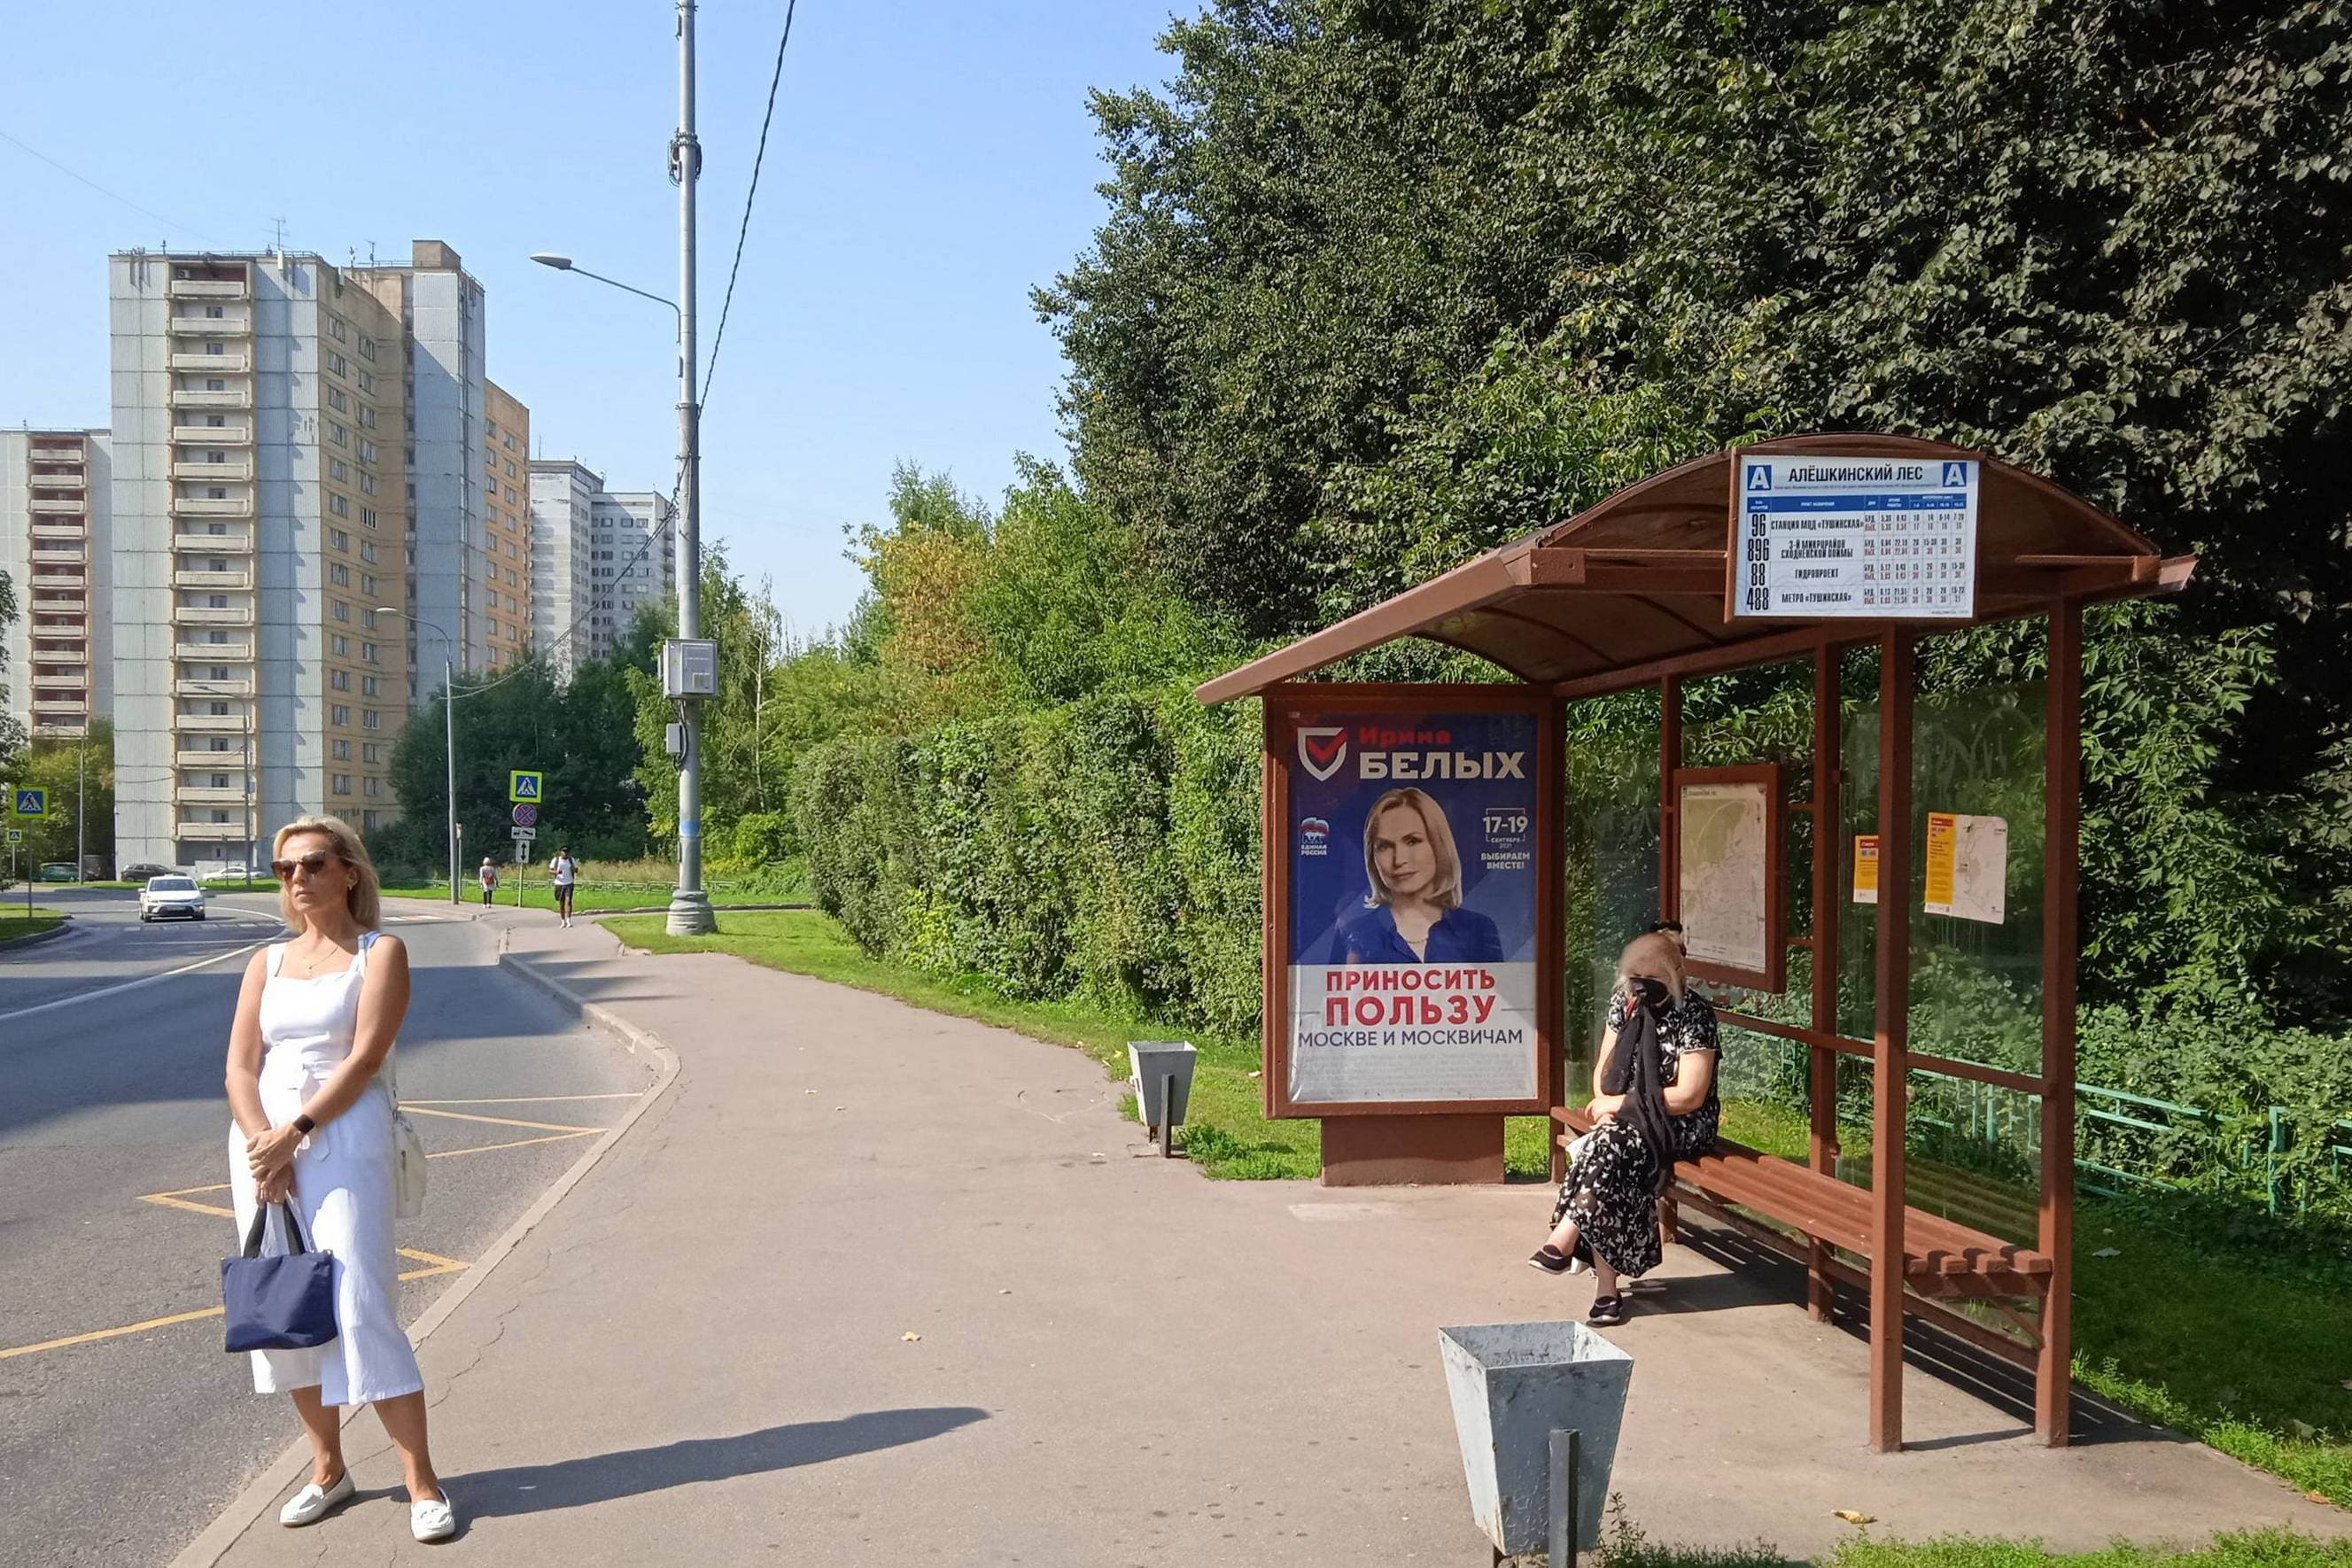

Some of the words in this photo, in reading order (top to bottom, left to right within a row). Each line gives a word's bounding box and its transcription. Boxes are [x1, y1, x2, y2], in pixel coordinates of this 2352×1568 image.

[1789, 464, 1892, 483] АЛЁШКИНСКИЙ
[1897, 466, 1923, 480] ЛЕС
[1751, 514, 1766, 537] 96
[1771, 520, 1799, 531] СТАНЦИЯ
[1818, 518, 1864, 529] «ТУШИНСКАЯ»
[1747, 539, 1770, 562] 896
[1750, 563, 1766, 586] 88
[1795, 568, 1838, 579] ГИДРОПРОЕКТ
[1746, 587, 1769, 610] 488
[1781, 593, 1804, 603] МЕТРО
[1805, 592, 1851, 602] «ТУШИНСКАЯ»
[1359, 726, 1451, 748] Ирина
[1359, 751, 1525, 780] БЕЛЫХ
[1482, 815, 1529, 833] 17-19
[1480, 852, 1531, 861] ВЫБИРАЕМ
[1326, 969, 1495, 991] ПРИНОСИТЬ
[1326, 995, 1496, 1027] ПОЛЬЗУ
[1299, 1031, 1377, 1047] МОСКВЕ
[1383, 1031, 1395, 1045] И
[1401, 1029, 1523, 1045] МОСКВИЧАМ
